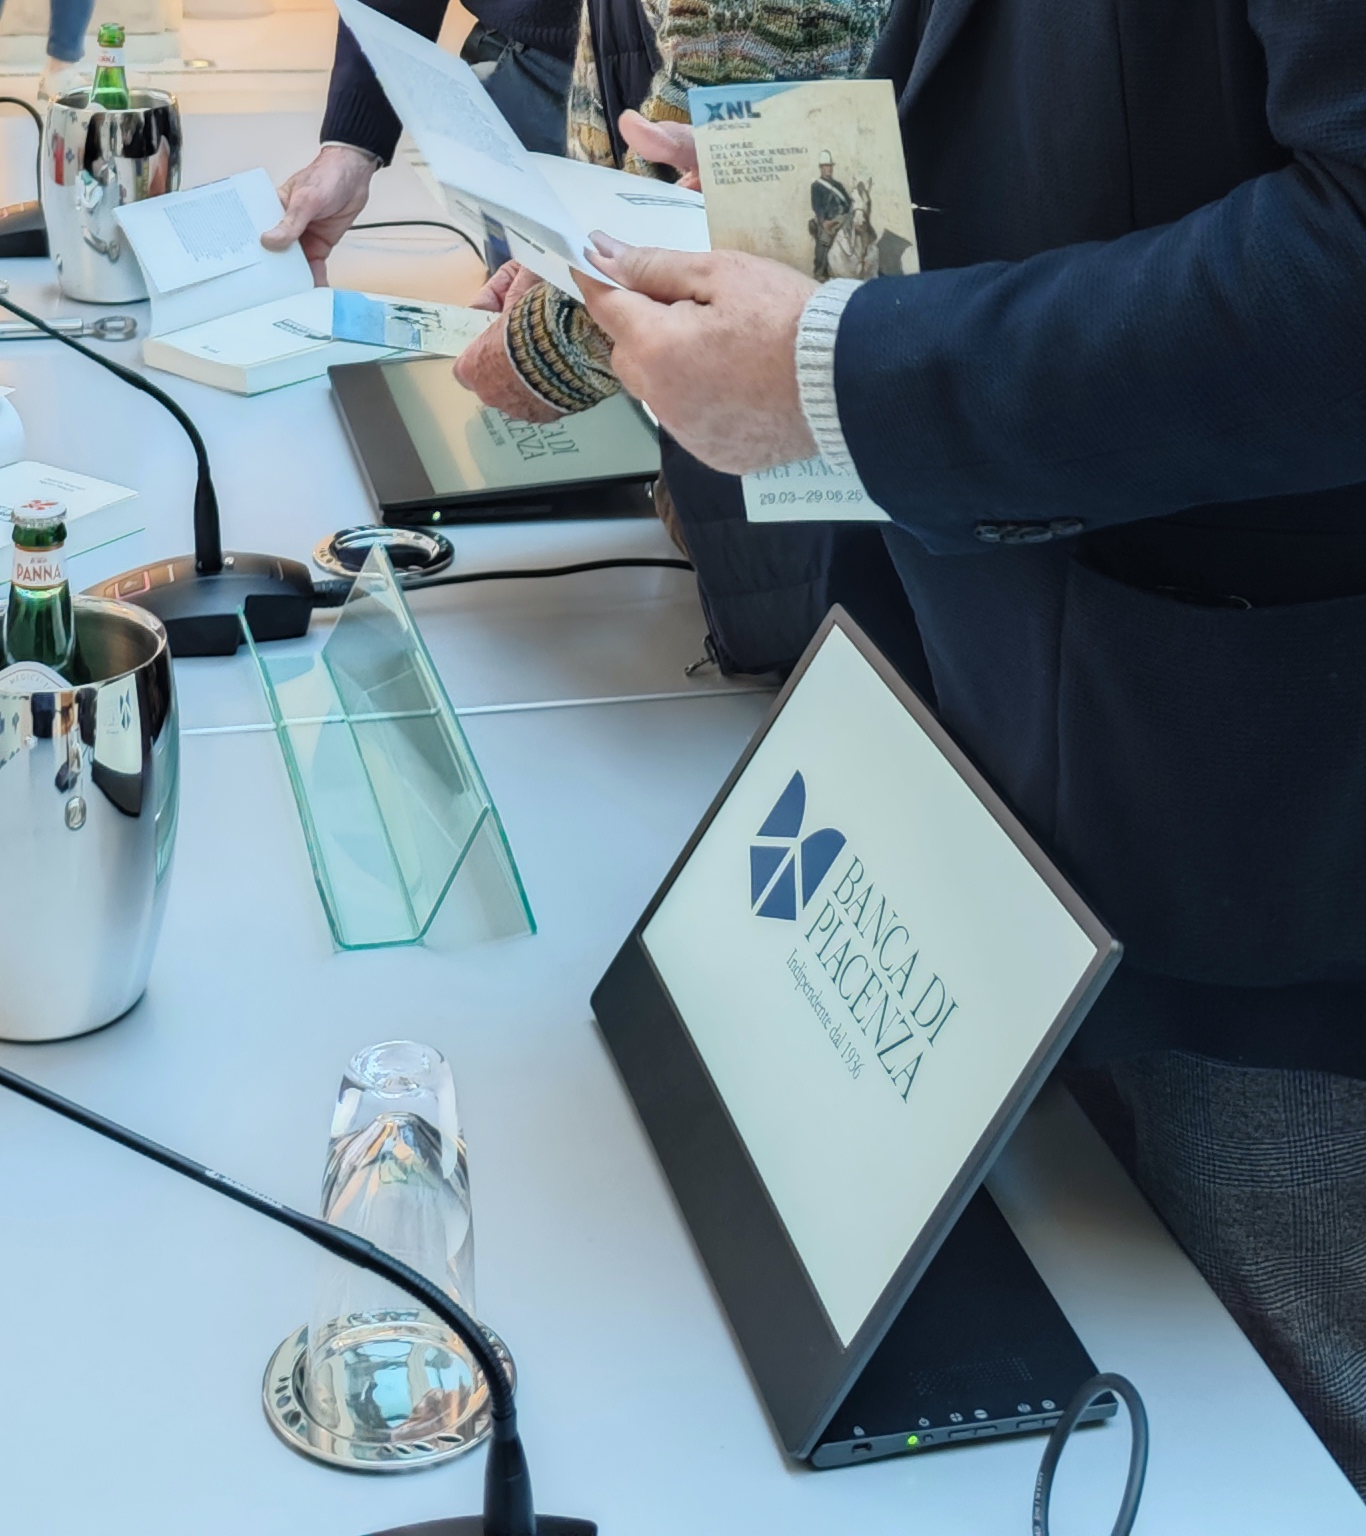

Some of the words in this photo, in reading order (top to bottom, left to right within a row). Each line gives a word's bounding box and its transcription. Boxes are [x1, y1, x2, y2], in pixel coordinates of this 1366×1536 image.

[704, 100, 761, 122] XNL
[17, 564, 61, 581] PANNA
[786, 948, 833, 1032] Indipendente
[828, 1021, 849, 1053] dal
[842, 1041, 864, 1081] 1936
[805, 898, 924, 1104] PIACENZA
[832, 855, 921, 997] BANCA
[910, 974, 959, 1048] DI
